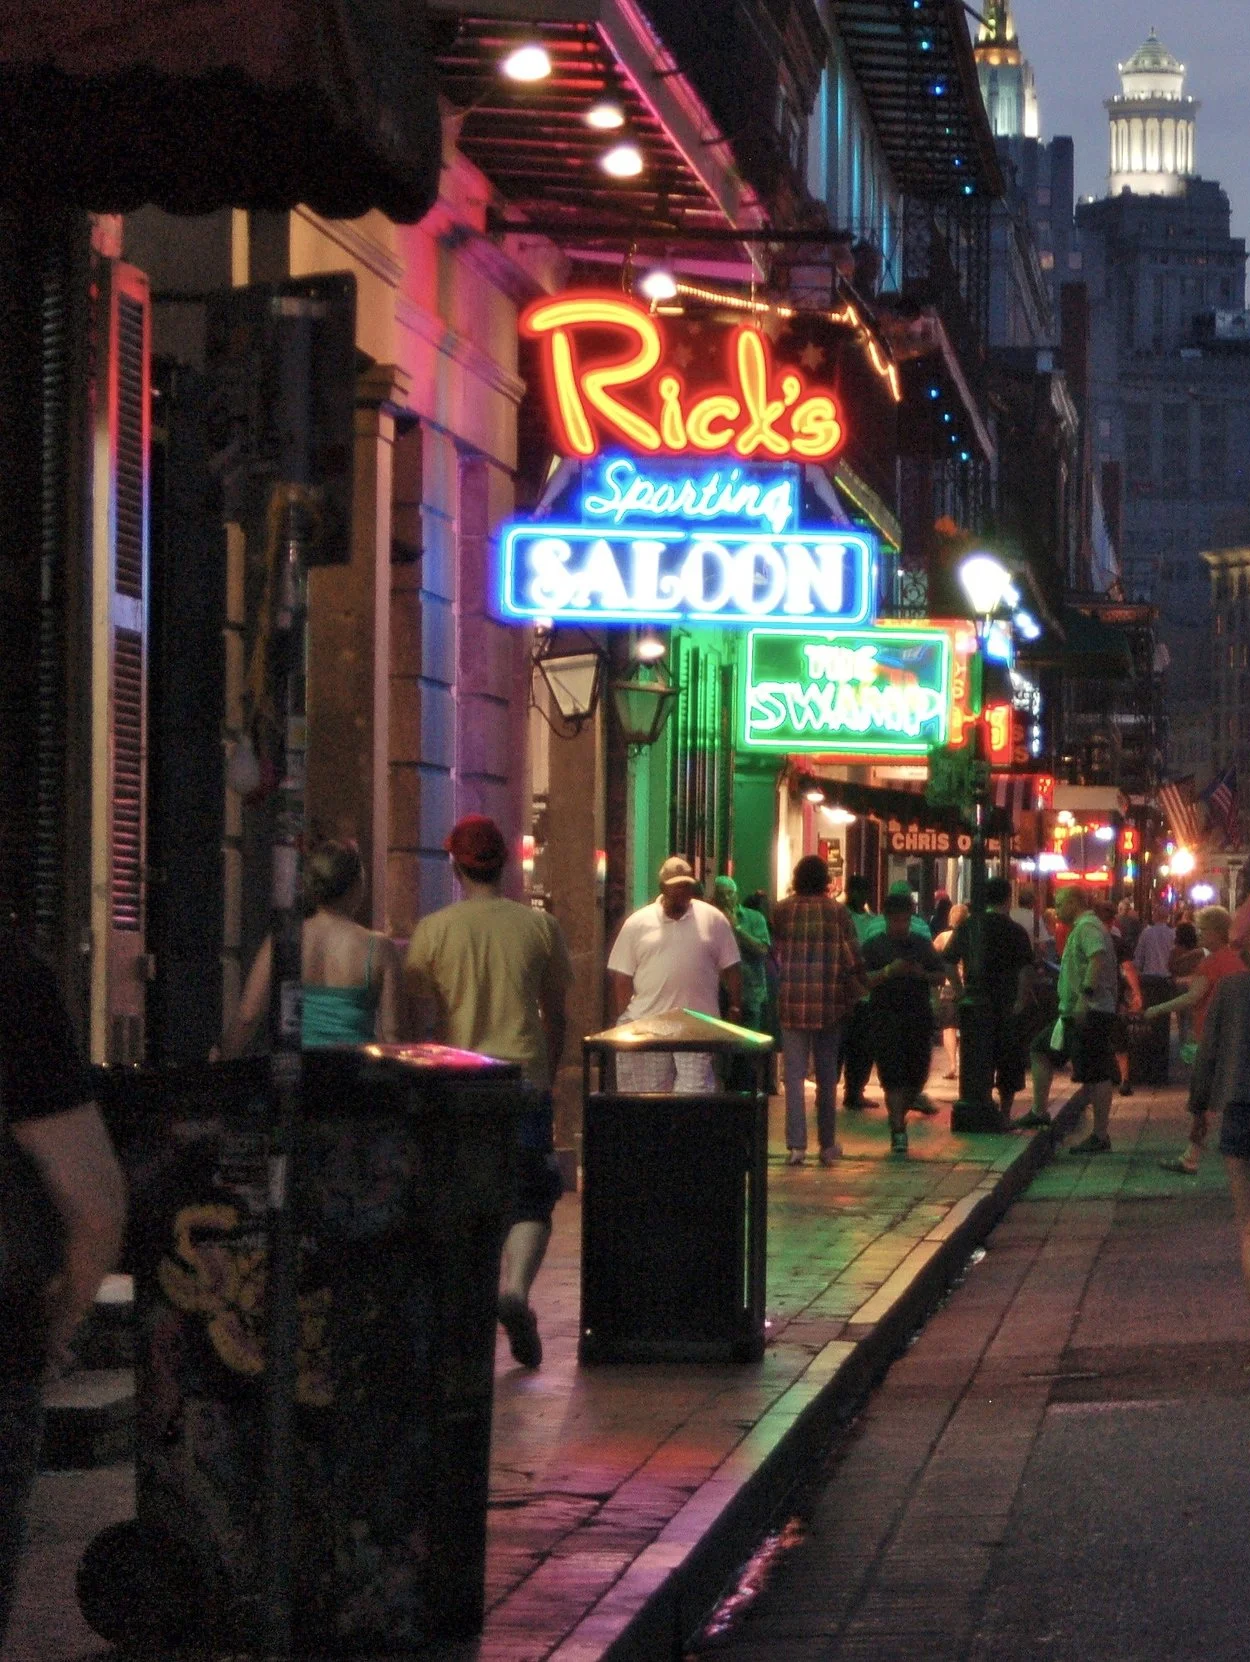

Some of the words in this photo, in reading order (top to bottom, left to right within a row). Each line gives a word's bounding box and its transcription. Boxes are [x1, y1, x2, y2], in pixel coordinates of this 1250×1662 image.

[528, 296, 843, 456] Rick's
[584, 459, 792, 532] Sporting
[529, 537, 848, 614] SALOON
[750, 682, 943, 737] SWAMP
[891, 832, 950, 851] CHRIS
